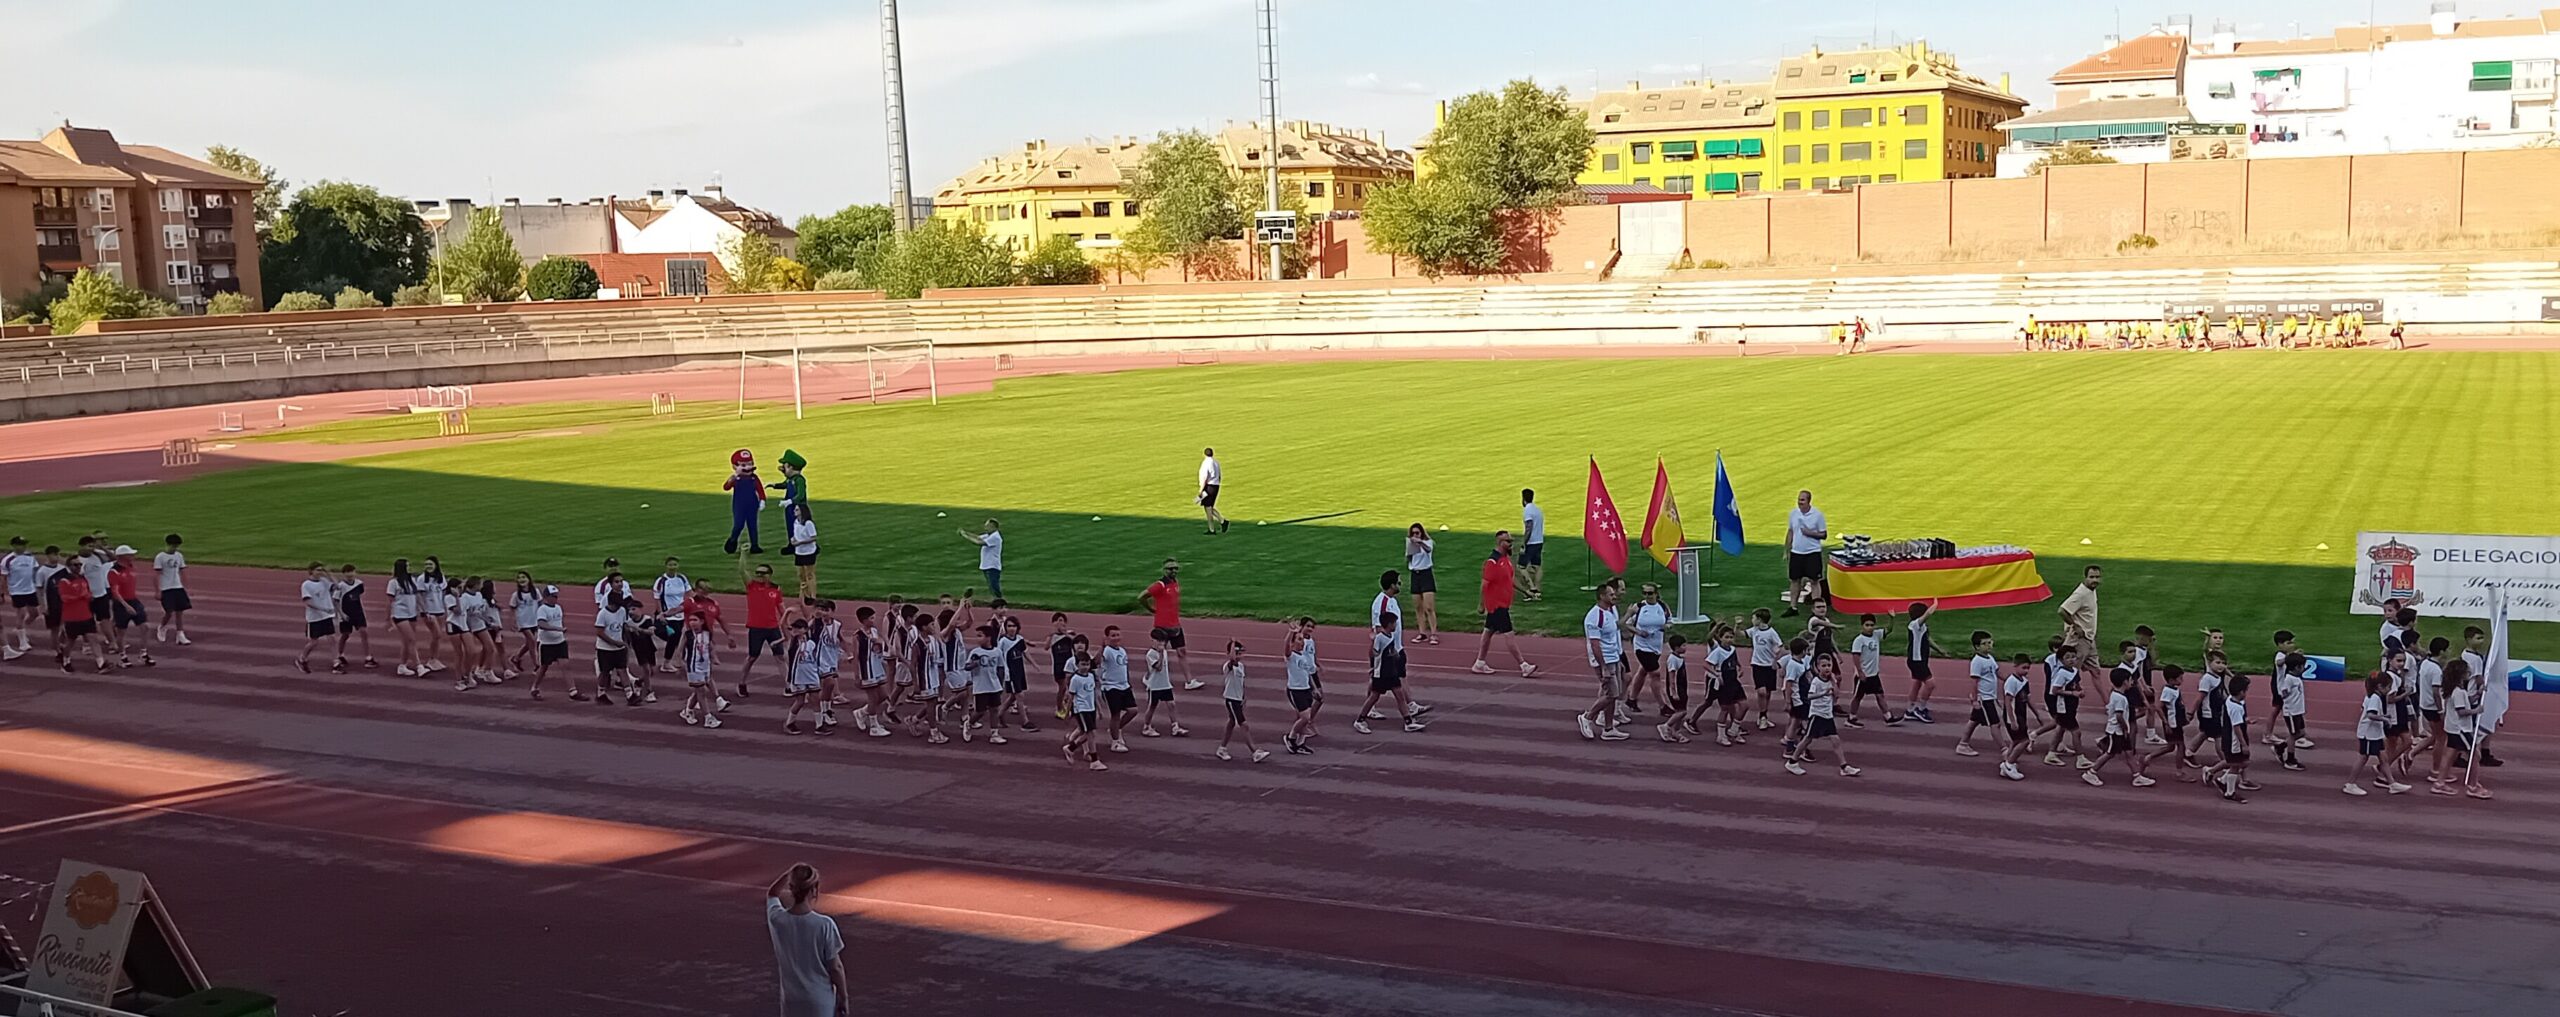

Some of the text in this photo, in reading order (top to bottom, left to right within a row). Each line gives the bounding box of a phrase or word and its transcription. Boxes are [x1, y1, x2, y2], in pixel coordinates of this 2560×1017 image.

[2433, 548, 2560, 564] DELEGACIO
[2429, 596, 2458, 607] del
[2302, 660, 2317, 678] 2
[2521, 671, 2533, 690] 1
